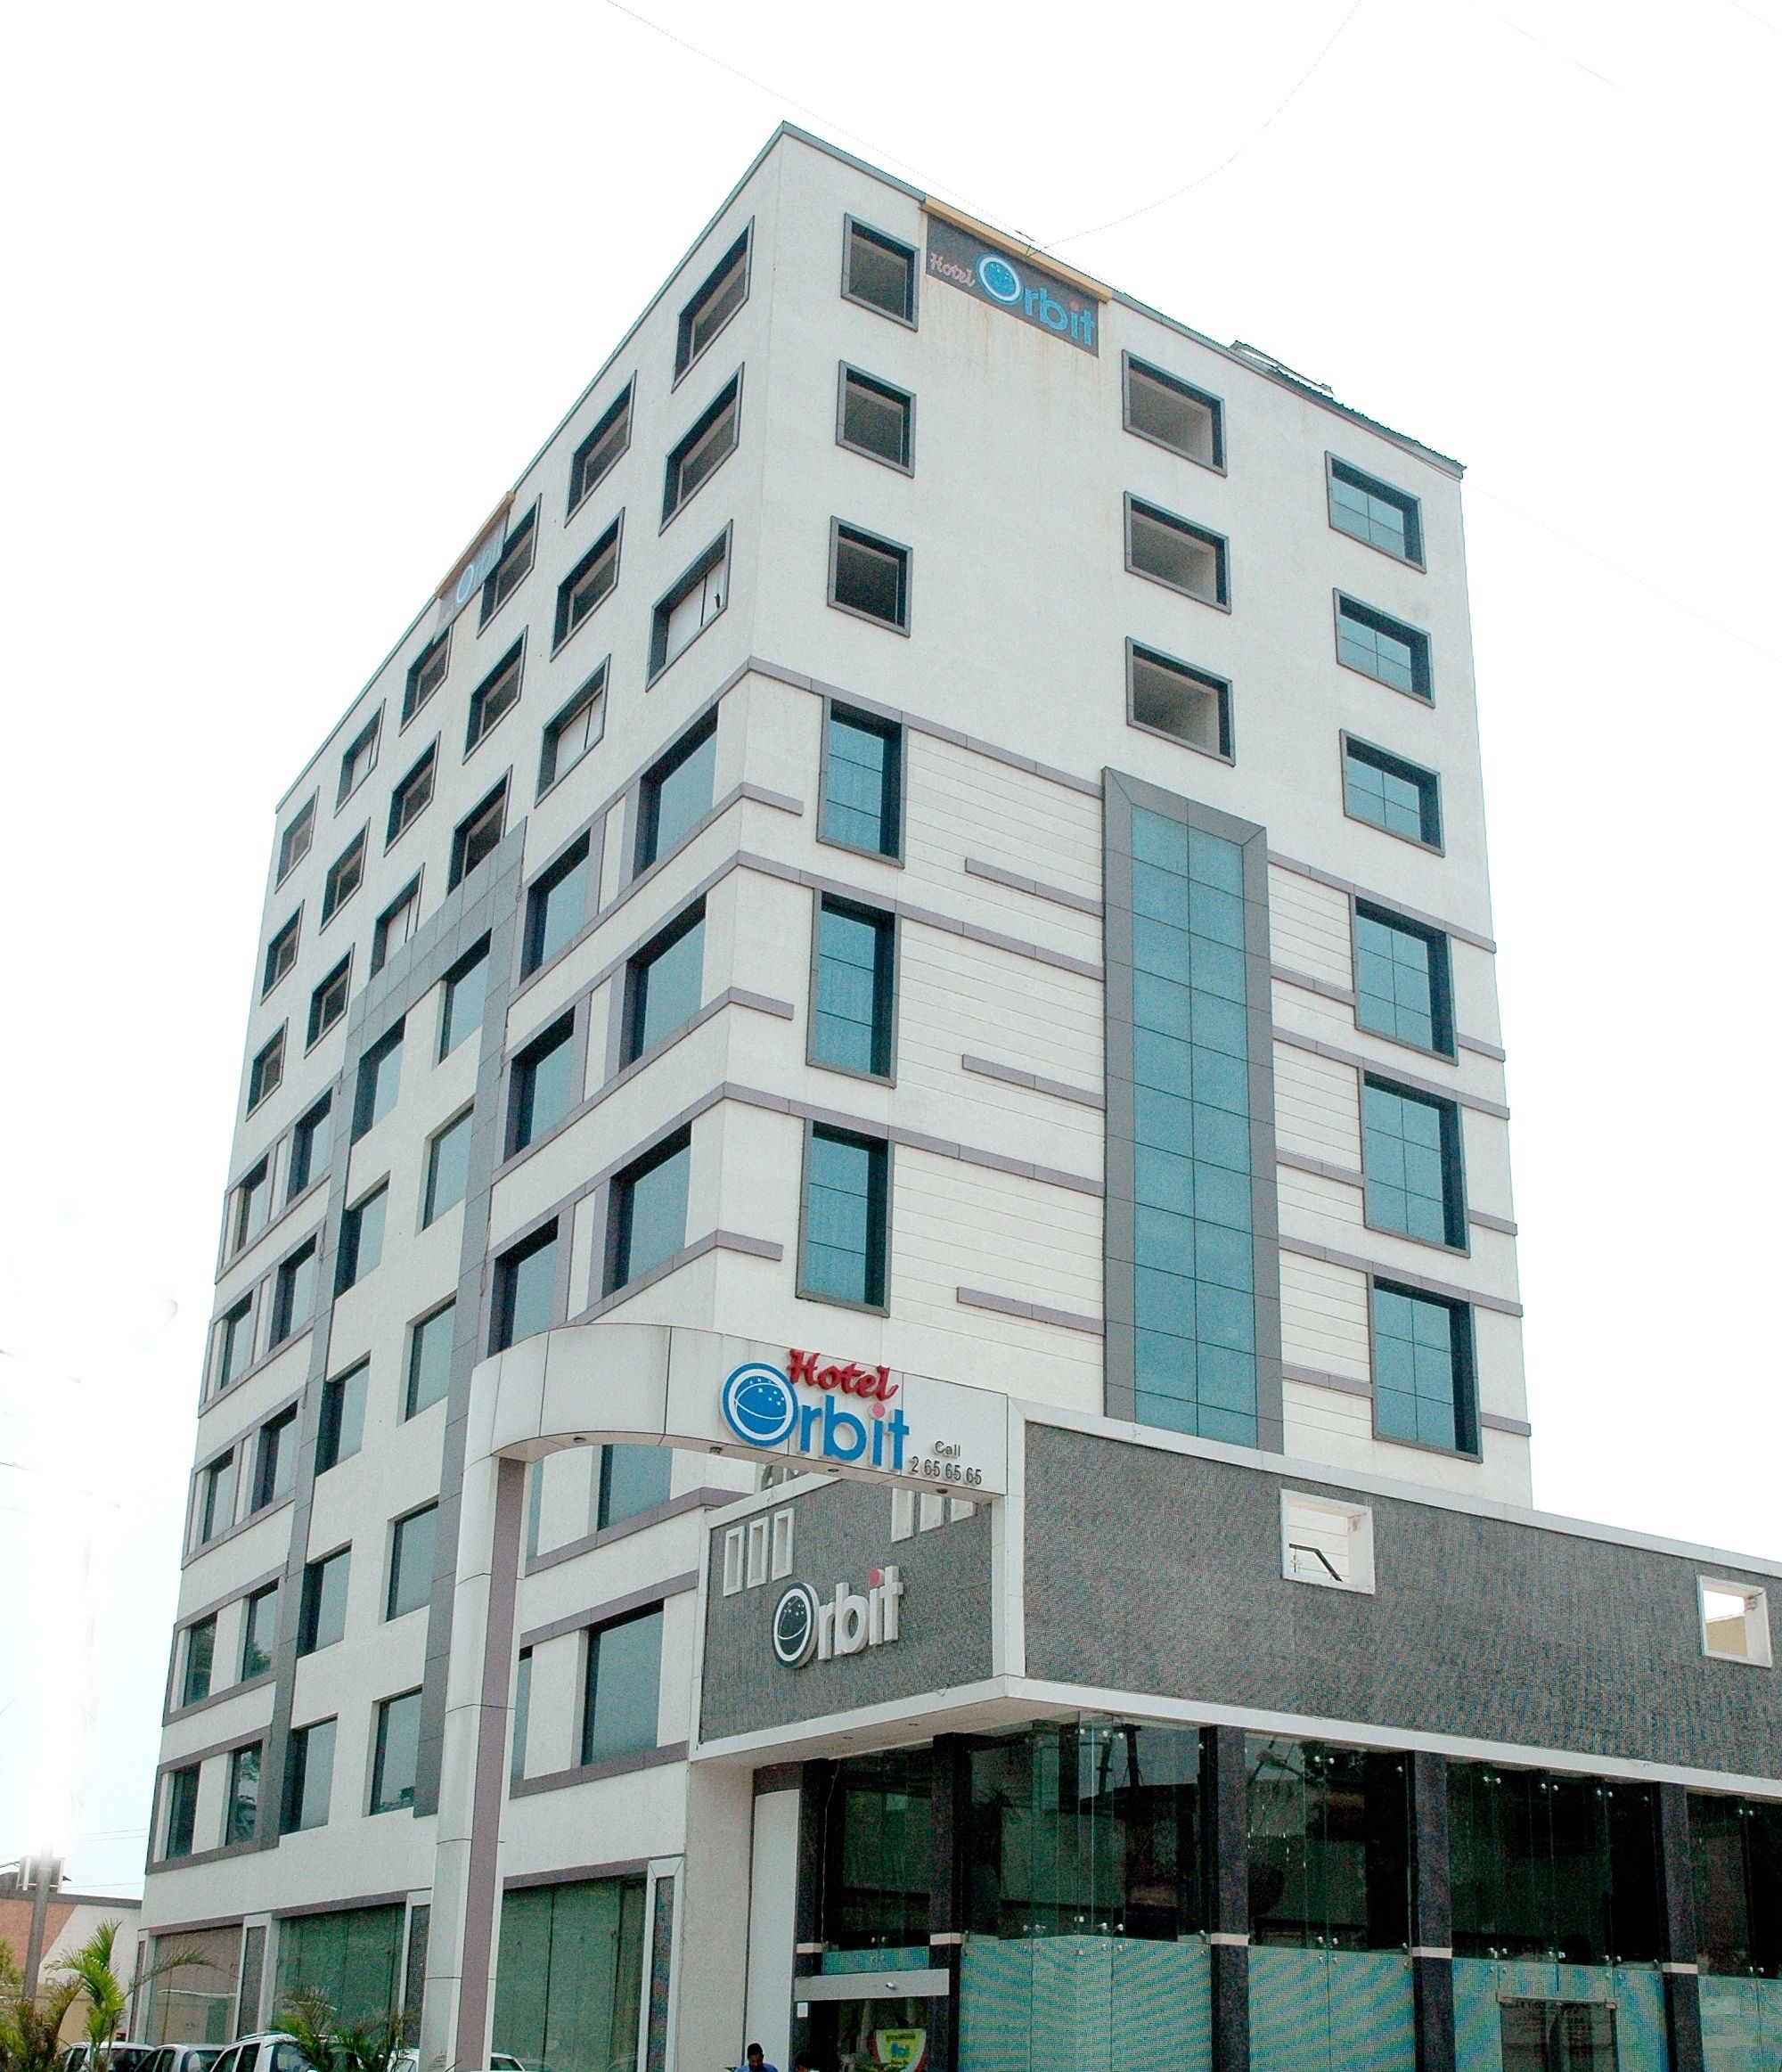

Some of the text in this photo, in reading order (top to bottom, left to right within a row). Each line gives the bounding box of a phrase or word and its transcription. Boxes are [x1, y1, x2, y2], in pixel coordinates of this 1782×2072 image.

[930, 250, 1095, 347] Hotel Orbit
[721, 1361, 910, 1471] Orbit
[787, 1348, 900, 1401] Hotel
[935, 1440, 960, 1457] Call
[772, 1566, 903, 1669] Orbit
